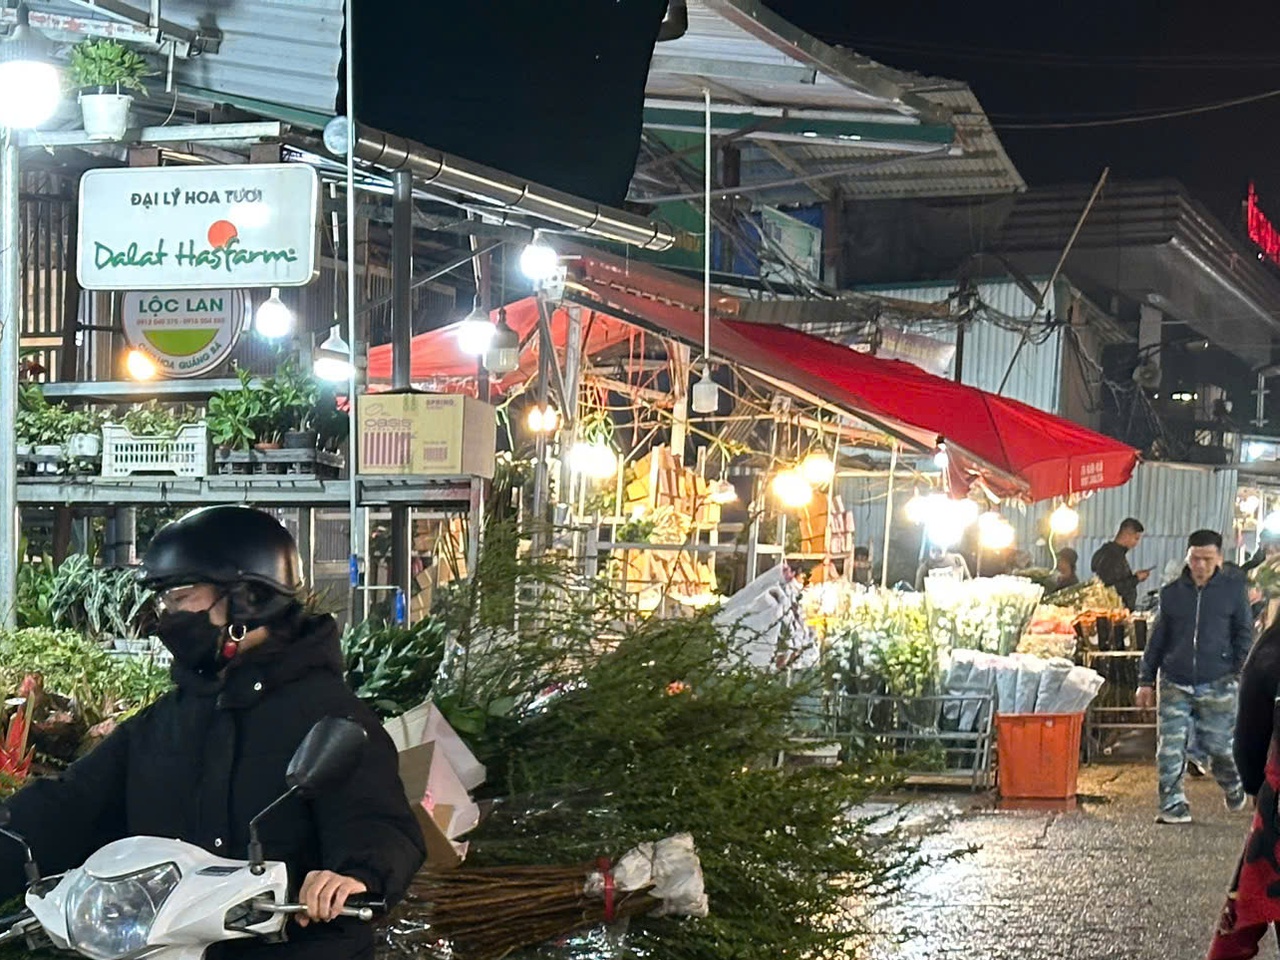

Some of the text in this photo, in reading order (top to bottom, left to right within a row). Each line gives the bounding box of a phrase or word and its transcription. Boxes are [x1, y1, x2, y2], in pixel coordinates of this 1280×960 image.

[131, 192, 158, 209] ĐẠI
[185, 190, 220, 204] HOA
[94, 237, 294, 272] Dalat Hasfarm
[138, 295, 224, 317] LỘC LAN
